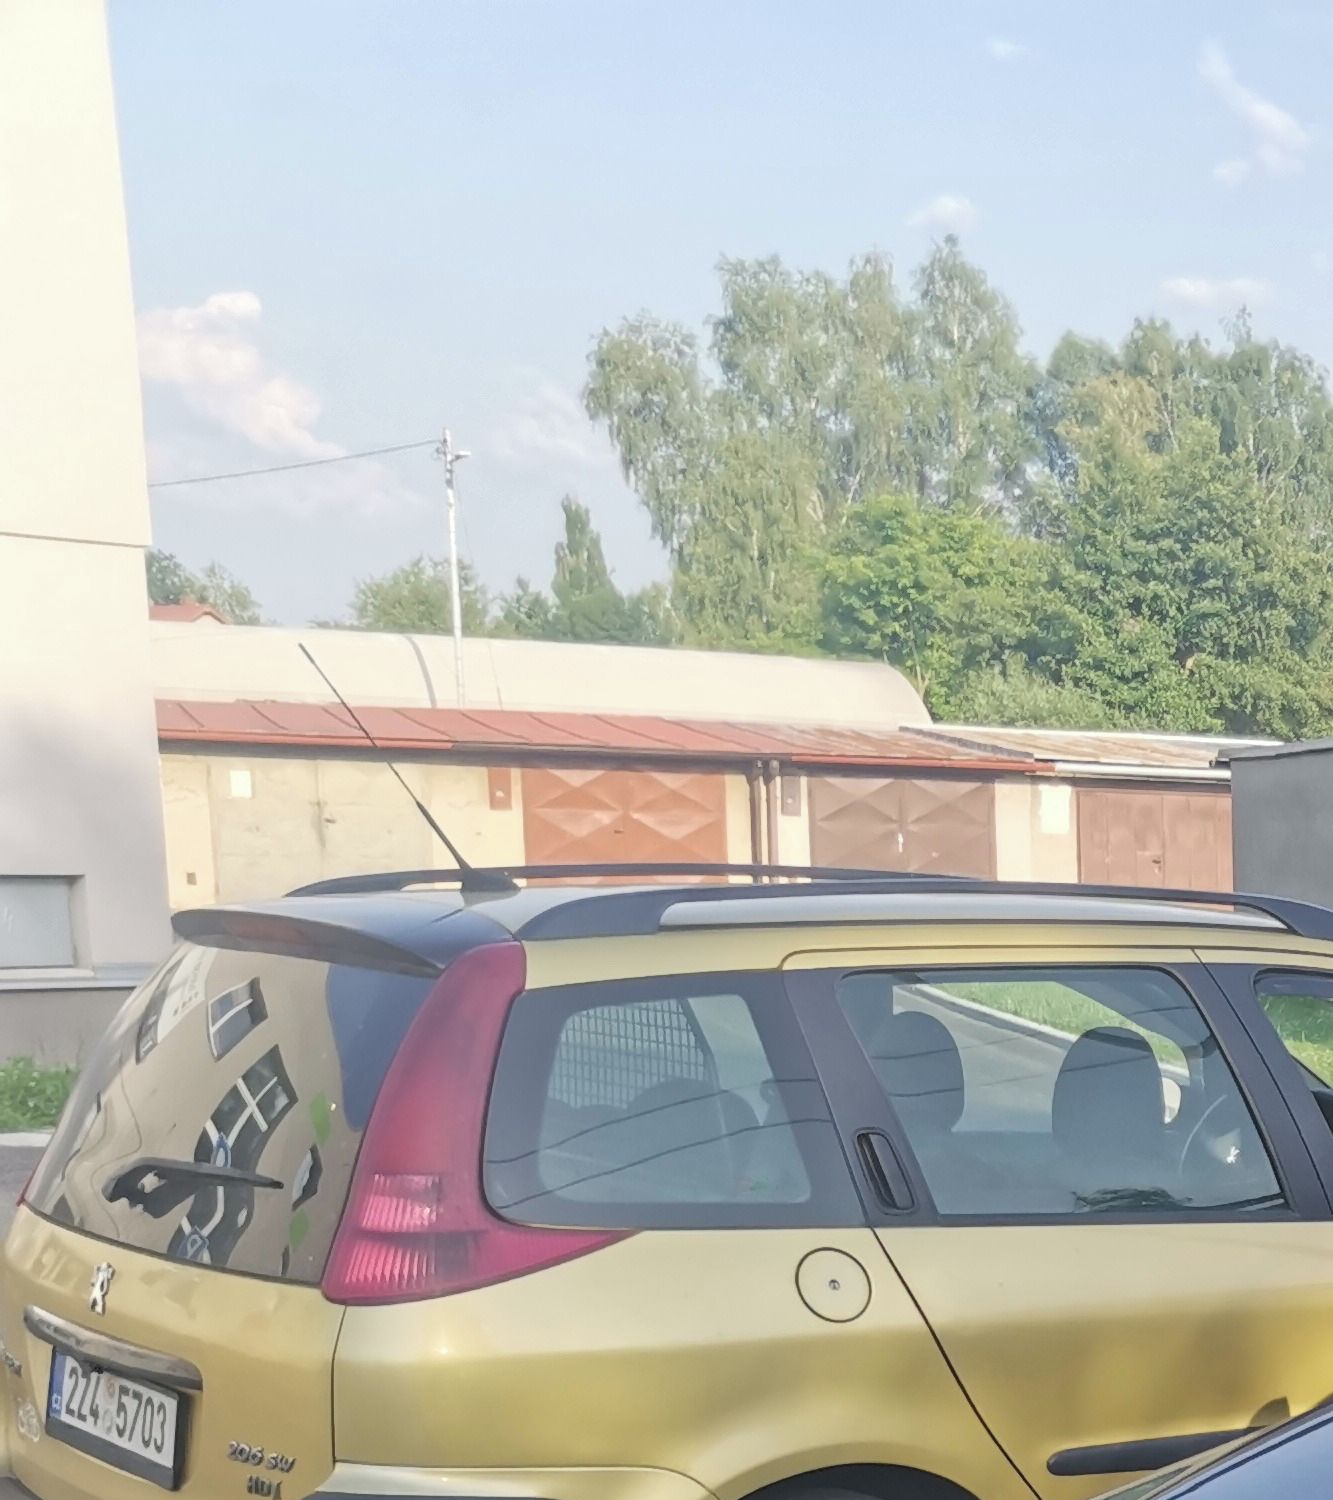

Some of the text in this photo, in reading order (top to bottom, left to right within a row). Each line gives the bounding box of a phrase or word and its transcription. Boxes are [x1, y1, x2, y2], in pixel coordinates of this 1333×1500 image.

[116, 1384, 167, 1454] 5703
[227, 1440, 296, 1473] 206 SW
